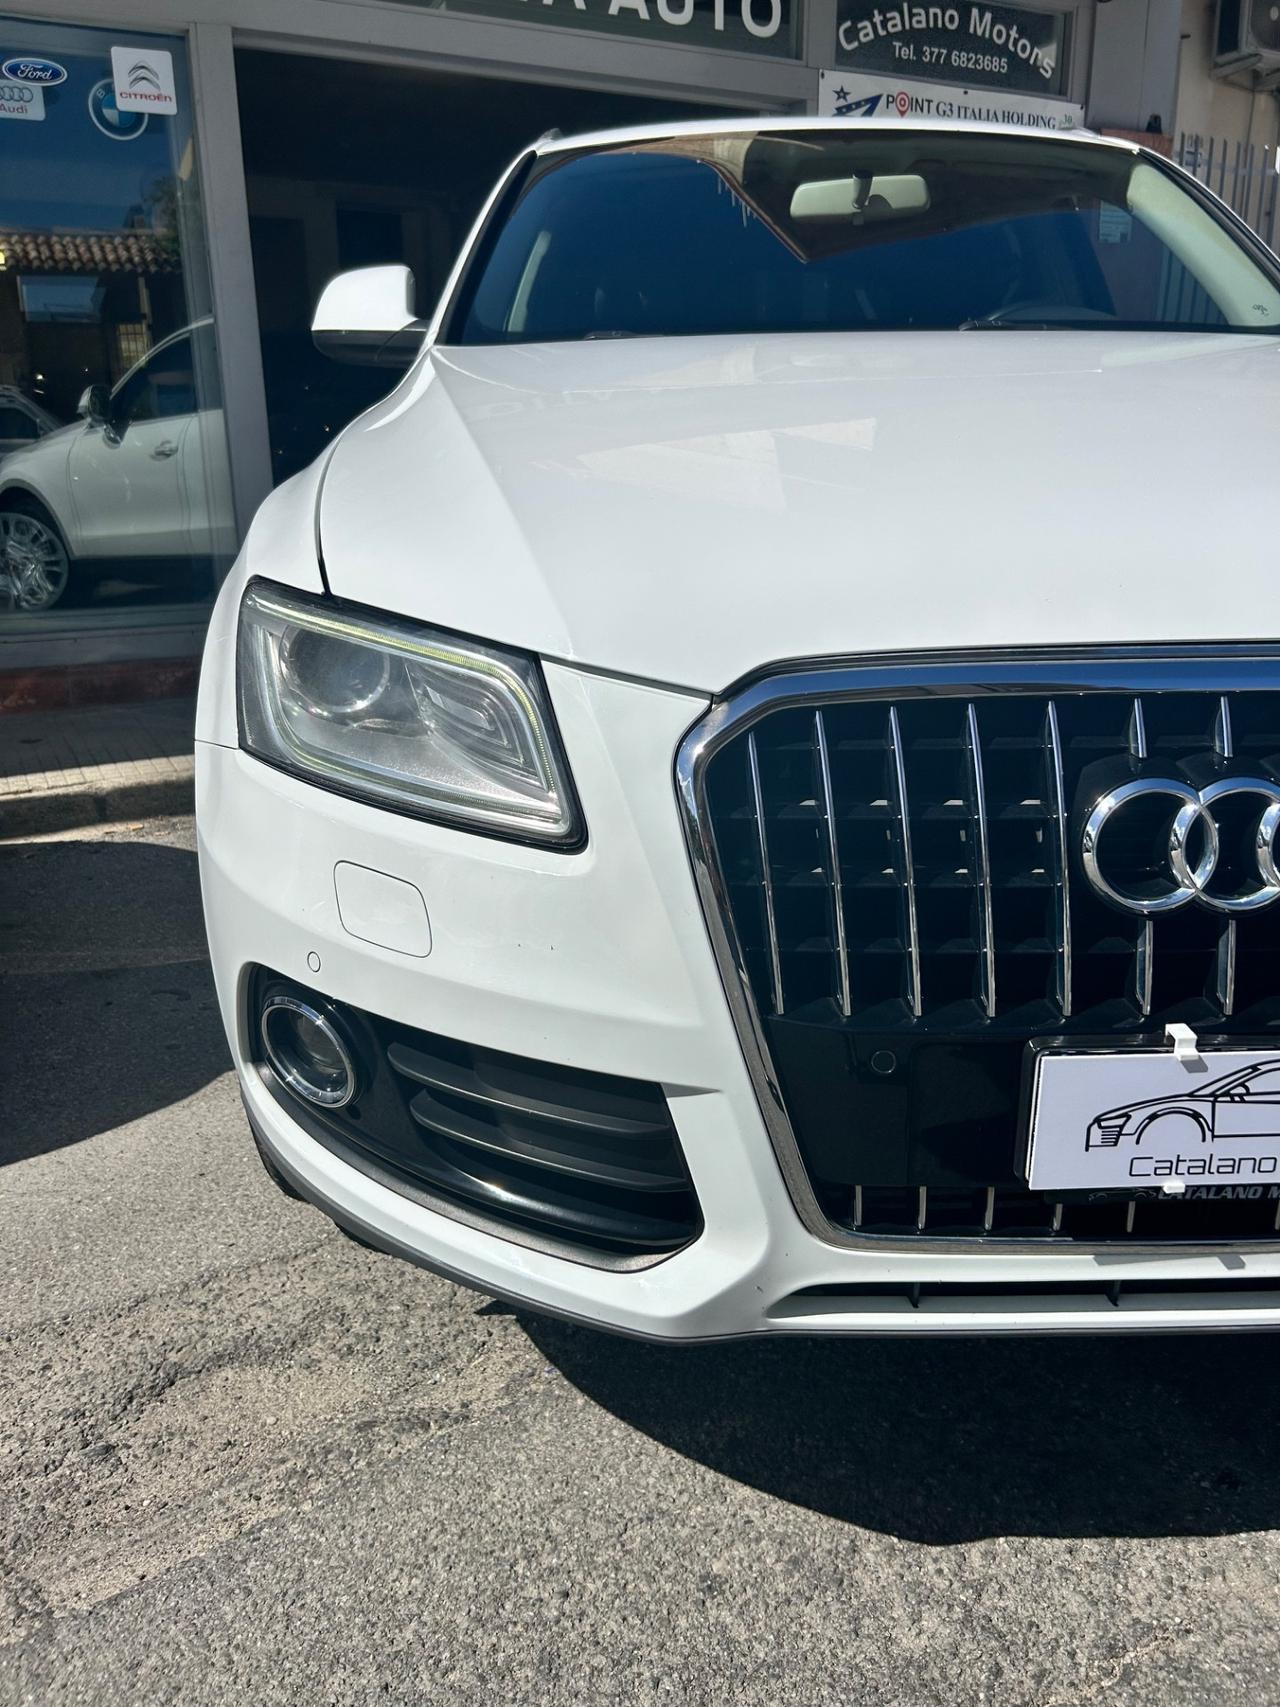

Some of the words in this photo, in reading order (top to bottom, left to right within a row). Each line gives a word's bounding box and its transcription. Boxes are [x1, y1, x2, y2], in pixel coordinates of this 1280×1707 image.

[838, 3, 960, 51] Catalano
[968, 7, 1056, 79] Motors
[892, 42, 917, 60] Tel.
[922, 46, 948, 65] 377
[951, 51, 1009, 74] 6823685
[17, 63, 53, 80] Ford
[0, 103, 28, 114] Audi
[936, 101, 954, 118] G3
[957, 105, 1000, 124] ITALIA
[1002, 110, 1057, 130] HOLDING
[1129, 1153, 1278, 1177] Catalano
[1158, 1186, 1264, 1200] TALANO
